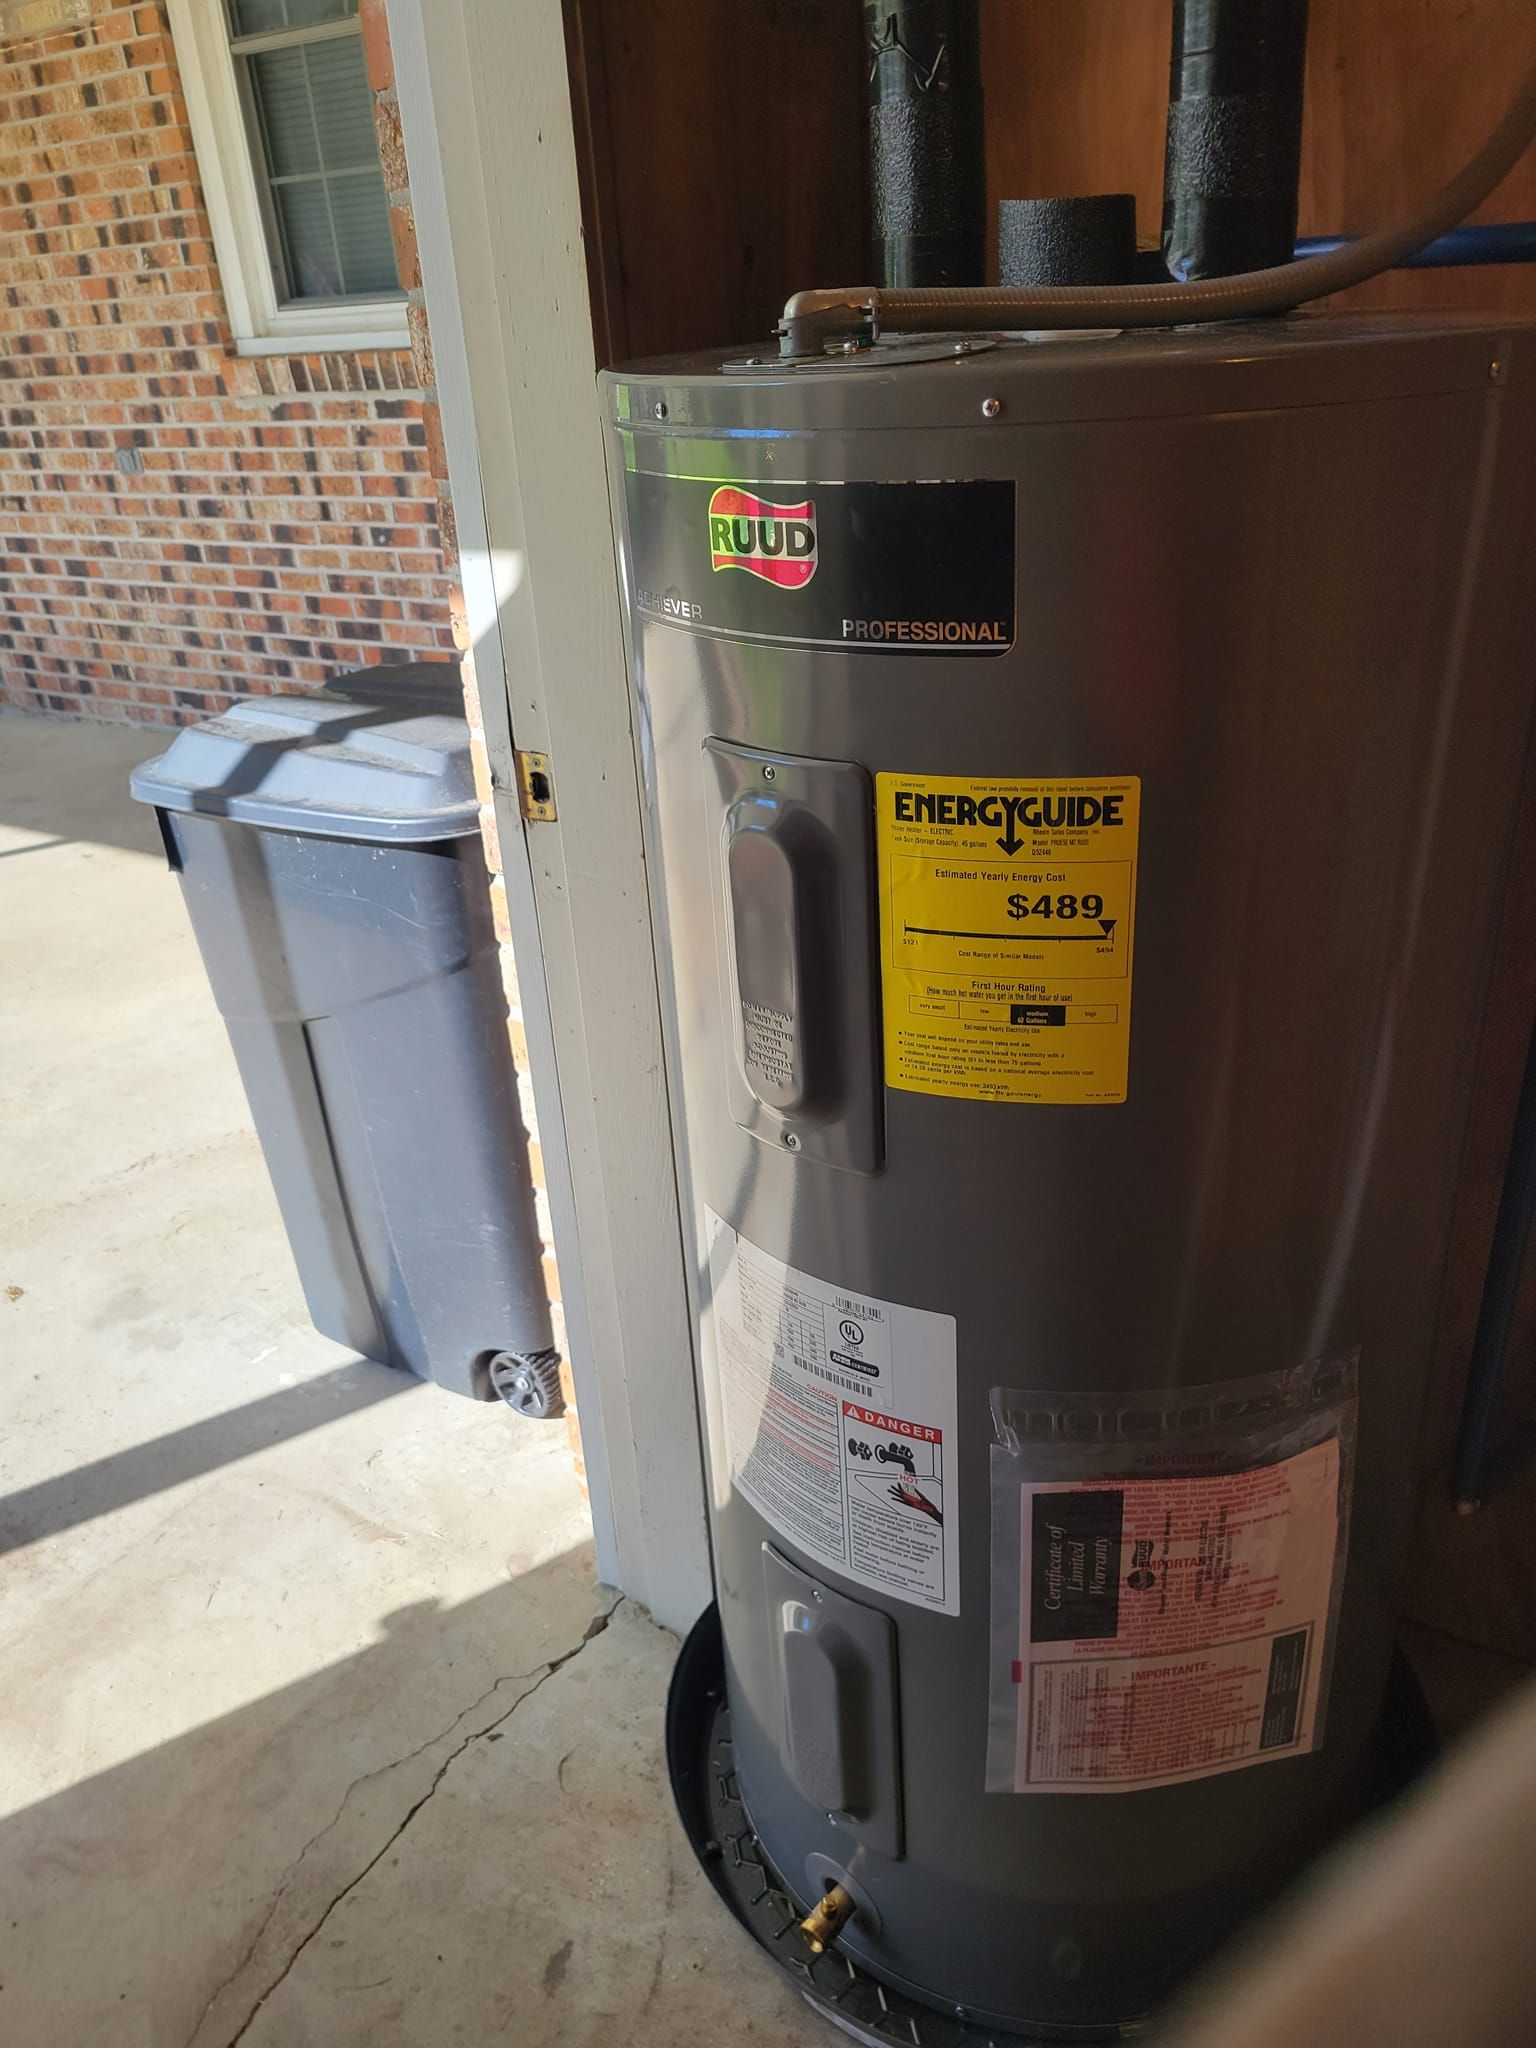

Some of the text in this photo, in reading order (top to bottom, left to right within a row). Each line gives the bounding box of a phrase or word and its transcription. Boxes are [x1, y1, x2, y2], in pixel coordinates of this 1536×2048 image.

[710, 517, 815, 557] RUUD
[638, 588, 703, 620] ACHIEVER
[842, 619, 1007, 641] PROFESSIONAL
[895, 791, 1124, 829] ENERGYGUIDE
[930, 827, 954, 836] ELECTRIC
[915, 837, 935, 846] (Storage
[969, 841, 988, 849] gallons
[936, 869, 1066, 883] Estimated Yearly Energy Cost
[1007, 893, 1103, 920] $489
[973, 952, 991, 960] Range
[927, 986, 940, 995] (How
[942, 988, 957, 996] much
[959, 989, 967, 997] hot
[969, 990, 984, 999] water
[986, 993, 995, 1001] you
[997, 992, 1006, 1001] get
[972, 981, 1045, 993] First Hour Rating
[989, 1025, 1004, 1033] Yearly
[1006, 1026, 1030, 1034] Electricity
[845, 1324, 858, 1341] UL
[806, 1384, 837, 1401] CAUTION
[865, 1411, 935, 1440] DANGER
[900, 1474, 919, 1485] HOT
[1043, 1522, 1067, 1610] Certificate of
[1067, 1540, 1086, 1591] Limited
[1088, 1536, 1112, 1595] Warranty
[1131, 1661, 1208, 1681] IMPORTANTE
